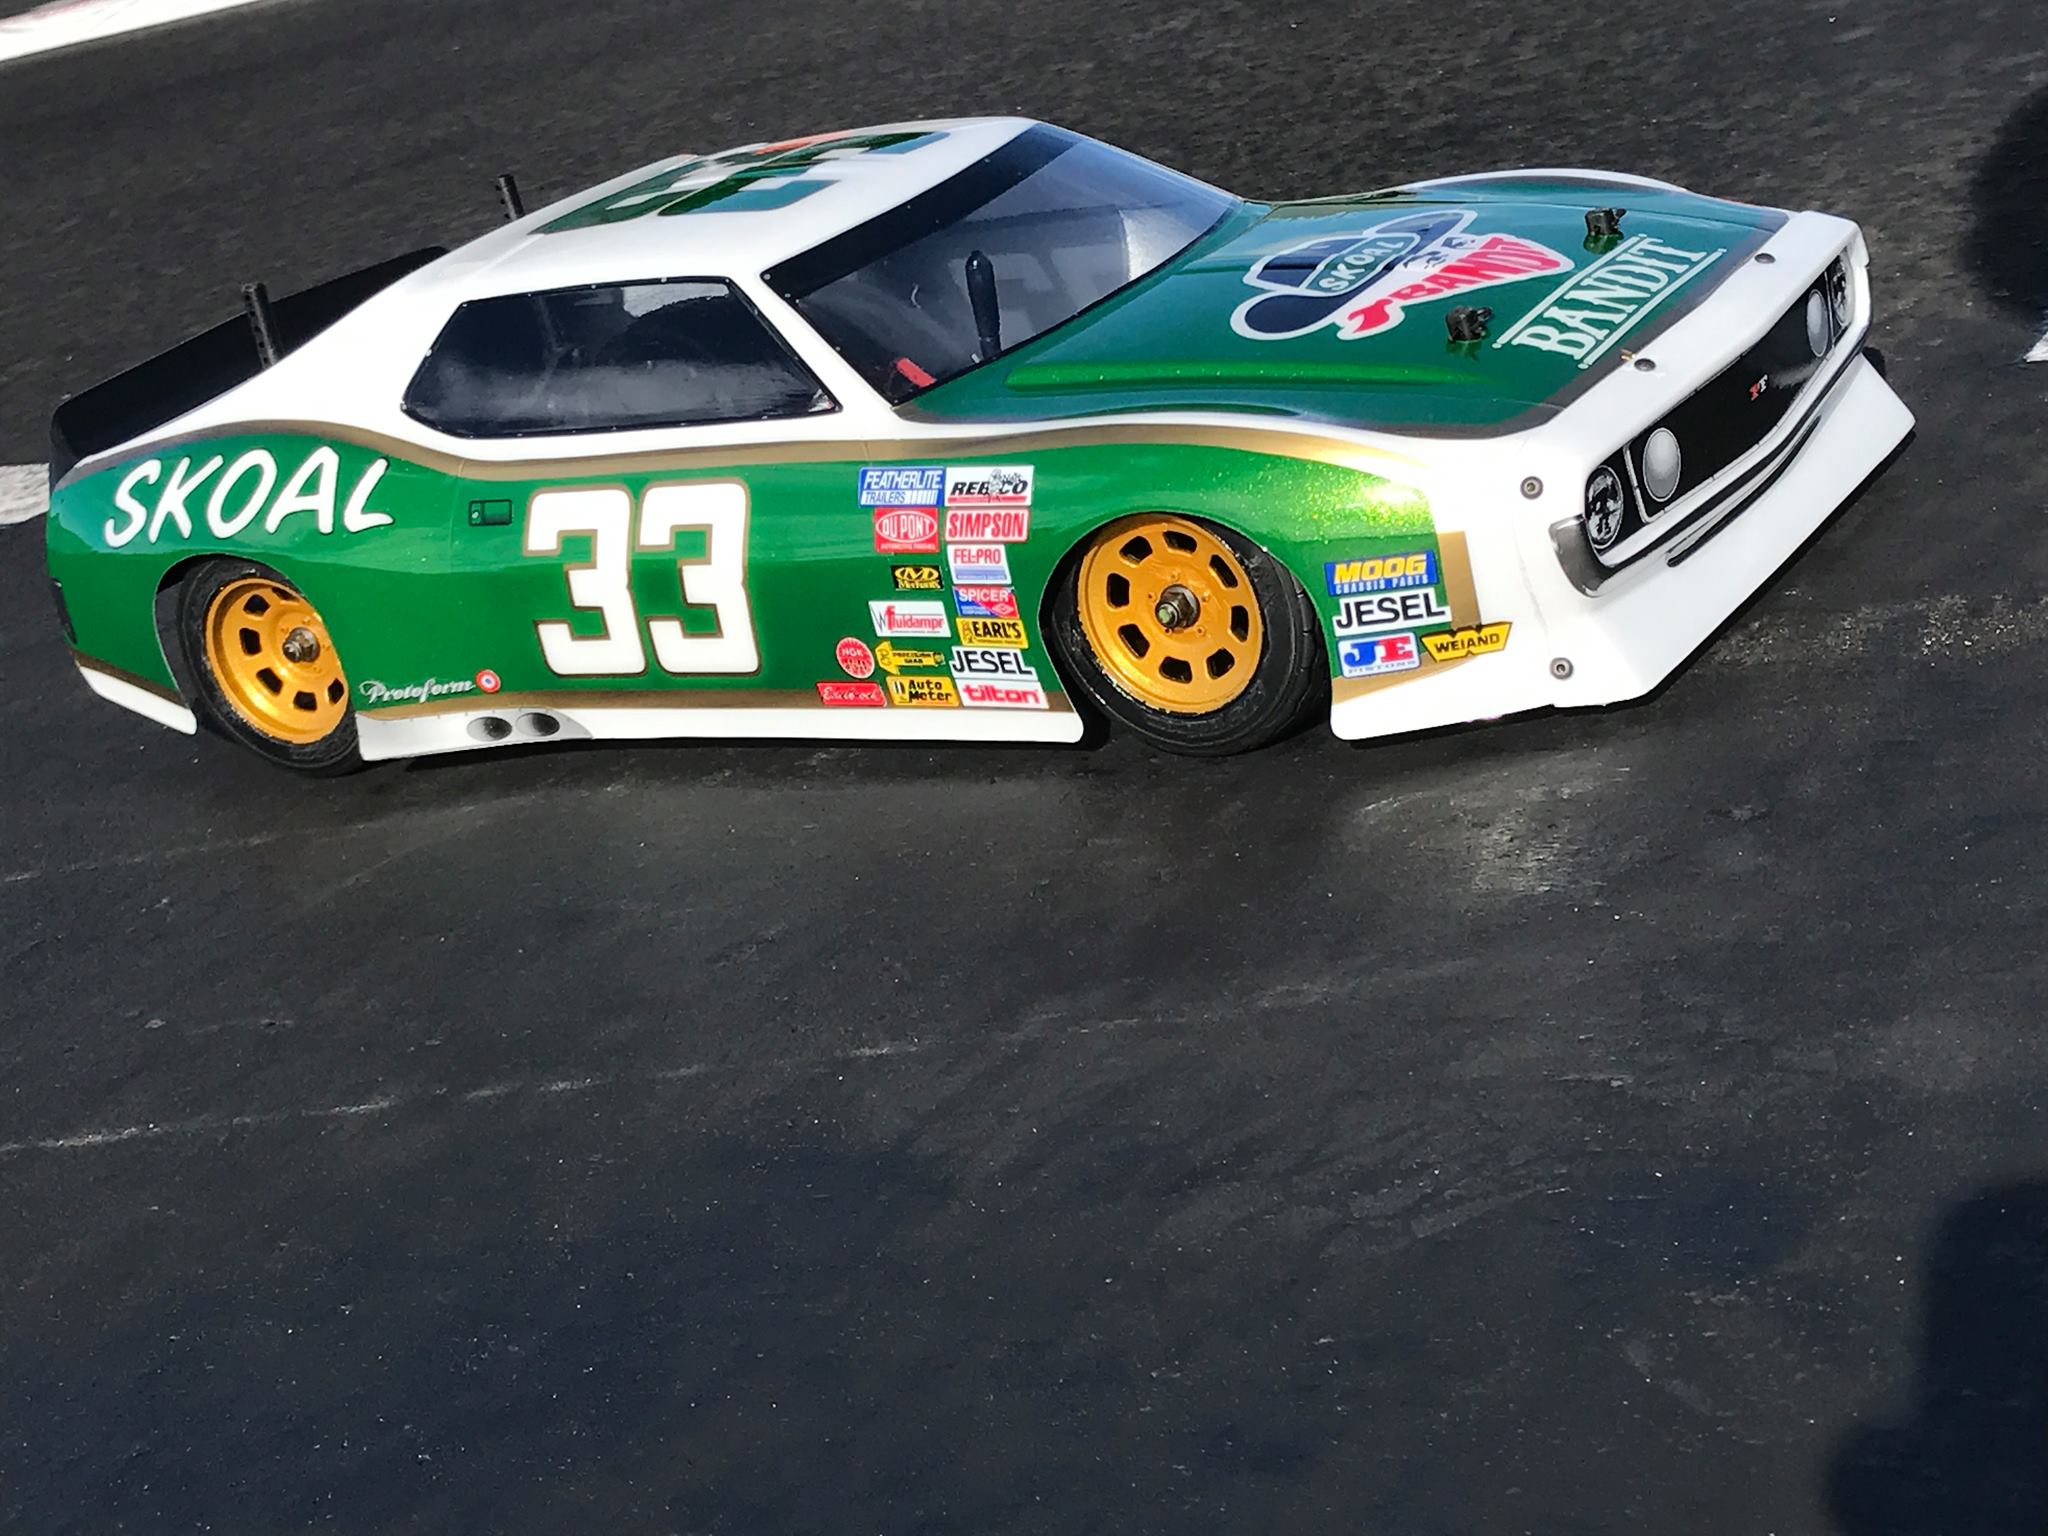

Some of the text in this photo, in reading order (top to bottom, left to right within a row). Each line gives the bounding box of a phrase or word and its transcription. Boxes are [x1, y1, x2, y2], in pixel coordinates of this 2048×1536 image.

[1318, 240, 1405, 292] SKOAL
[1512, 238, 1708, 361] BANDIT
[863, 470, 942, 490] FEATHERLITE
[104, 446, 395, 548] SKOAL
[865, 491, 907, 505] TRAILERS
[949, 512, 1025, 539] SIMPSON
[953, 548, 1002, 565] FEL-PRO
[1334, 553, 1427, 585] MOOG
[522, 477, 761, 678] 33
[1392, 573, 1429, 588] PARTS
[959, 588, 1009, 602] SPICER
[1335, 592, 1446, 630] JESEL
[971, 621, 1022, 639] EARL'S
[1434, 632, 1501, 654] WEIAND
[952, 650, 1033, 676] JESEL
[1344, 635, 1415, 668] JE
[359, 677, 476, 704] Protoform
[908, 679, 943, 691] Auto
[963, 684, 1041, 704] tilton
